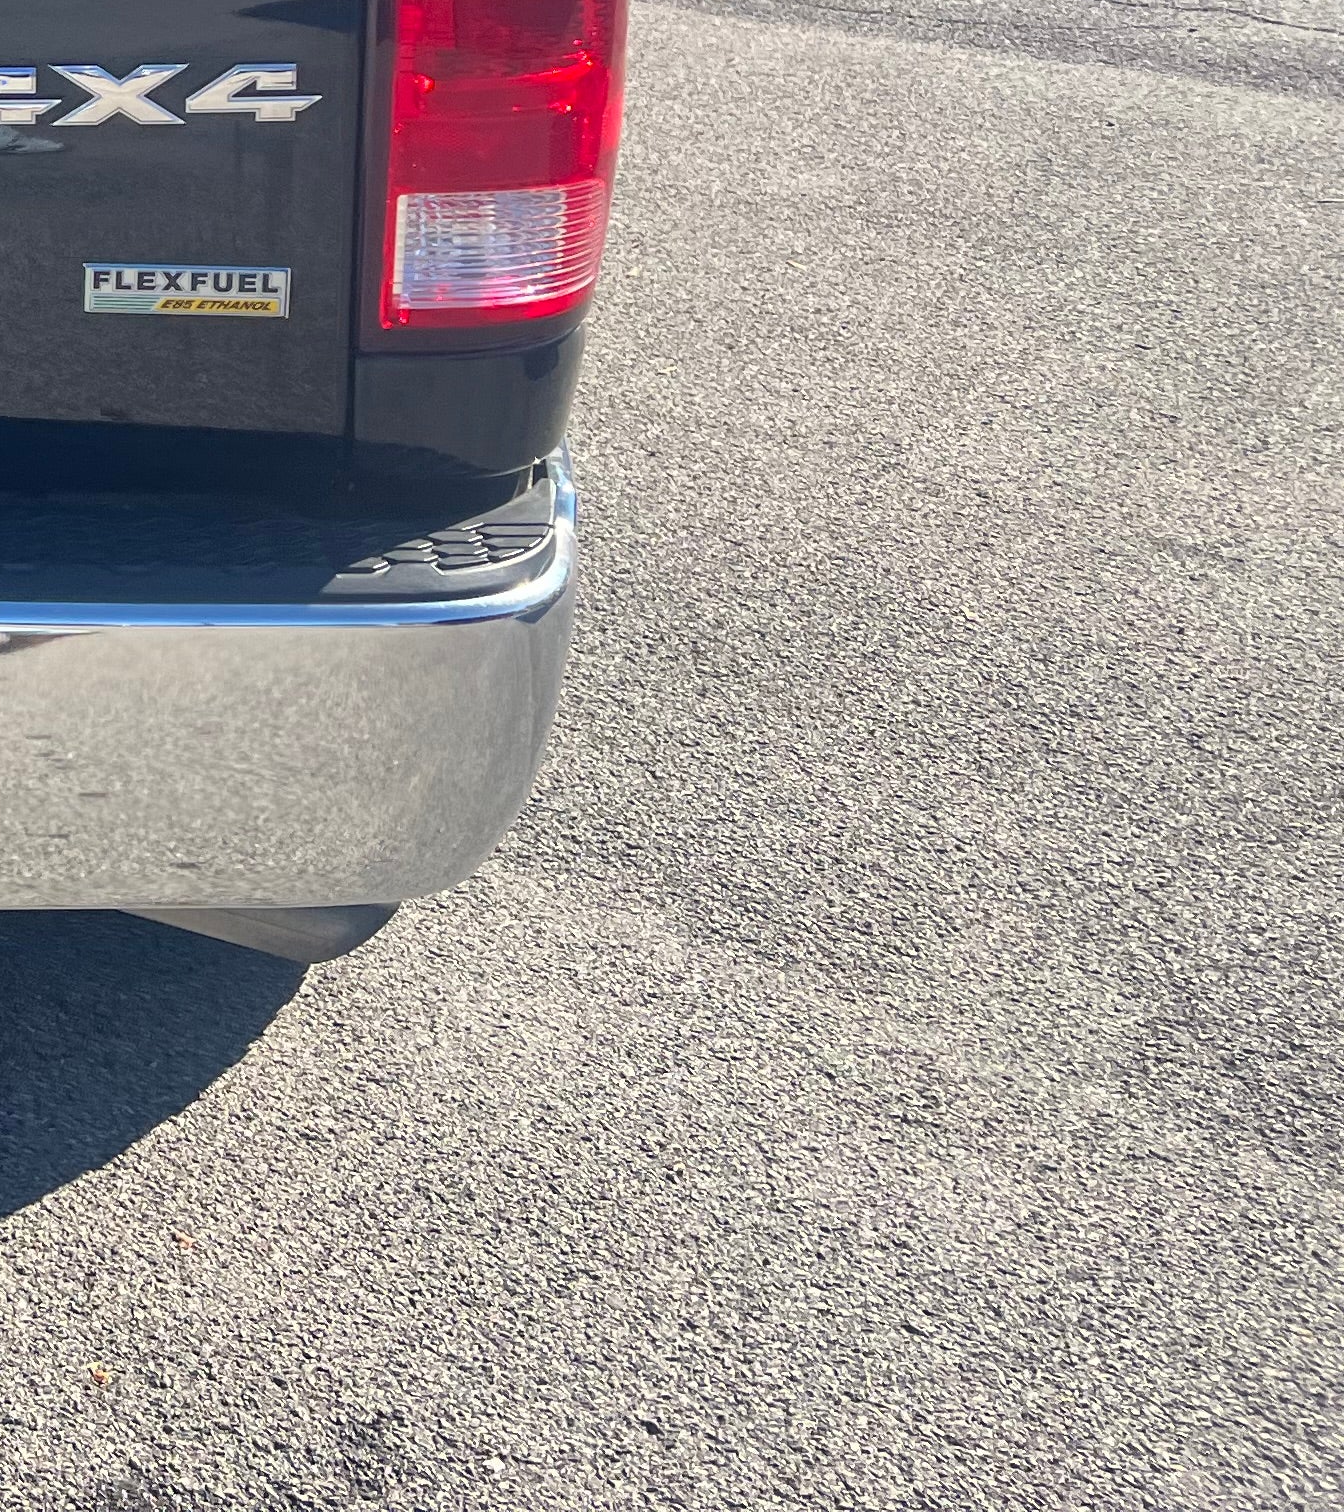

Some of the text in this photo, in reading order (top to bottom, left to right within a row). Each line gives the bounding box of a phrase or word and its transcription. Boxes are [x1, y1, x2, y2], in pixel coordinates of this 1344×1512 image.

[93, 271, 279, 293] FLEXFUEL
[161, 299, 272, 311] E85 ETHANOL
